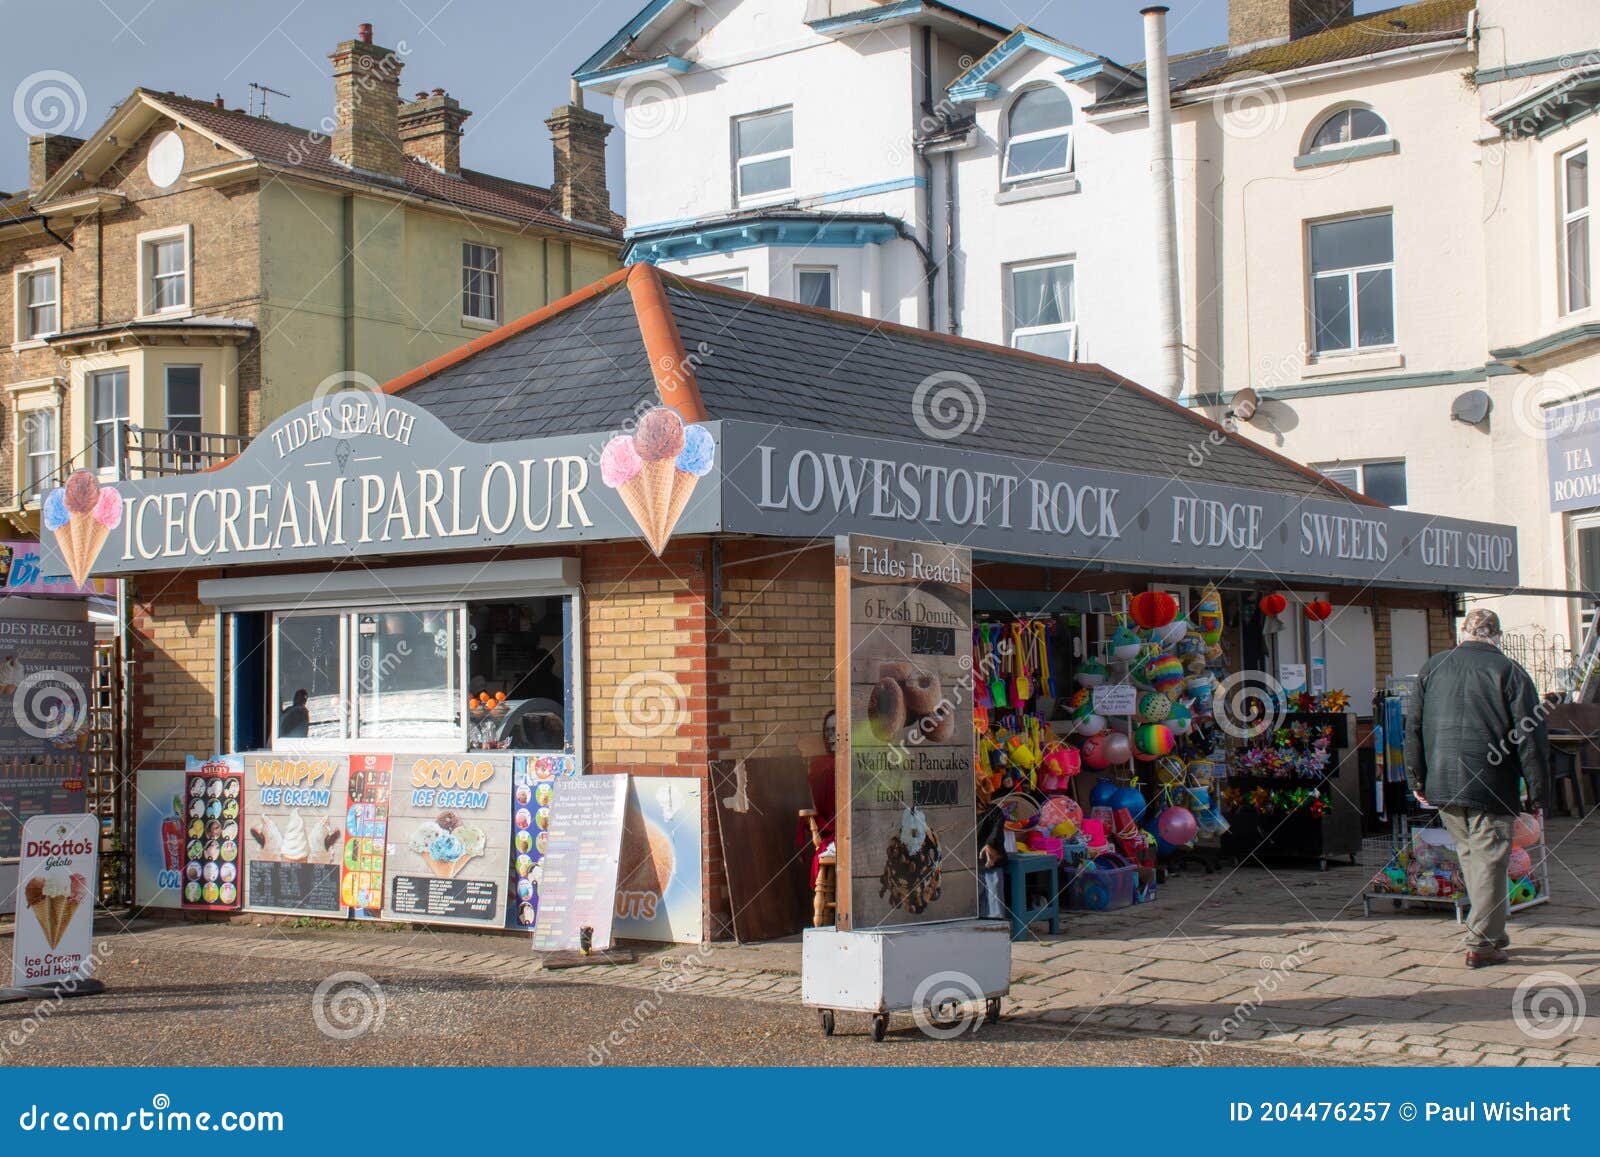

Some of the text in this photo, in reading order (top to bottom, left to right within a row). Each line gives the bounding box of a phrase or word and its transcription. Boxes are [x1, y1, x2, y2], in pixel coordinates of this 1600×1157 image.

[271, 404, 416, 459] TIDES REACH
[1564, 448, 1593, 472] TEA
[121, 455, 594, 561] ICECREAM PARLOUR
[757, 445, 1513, 573] LOWESTOFT ROCK FUDGE SWEETS GIFT SHOP
[858, 546, 962, 584] Tides Reach
[864, 598, 959, 625] 6 Fresh Donuts
[30, 624, 76, 637] REACH
[856, 751, 969, 771] Waffles or Pancakes
[255, 759, 338, 787] WHIPPY
[410, 758, 495, 789] SCOOP
[260, 788, 330, 807] ICE CREAM
[411, 789, 489, 809] ICE CREAM
[876, 783, 904, 803] from
[26, 838, 92, 857] DiSotto's
[45, 856, 72, 870] Gelato
[25, 953, 81, 967] Ice Cream
[26, 965, 50, 979] Sold
